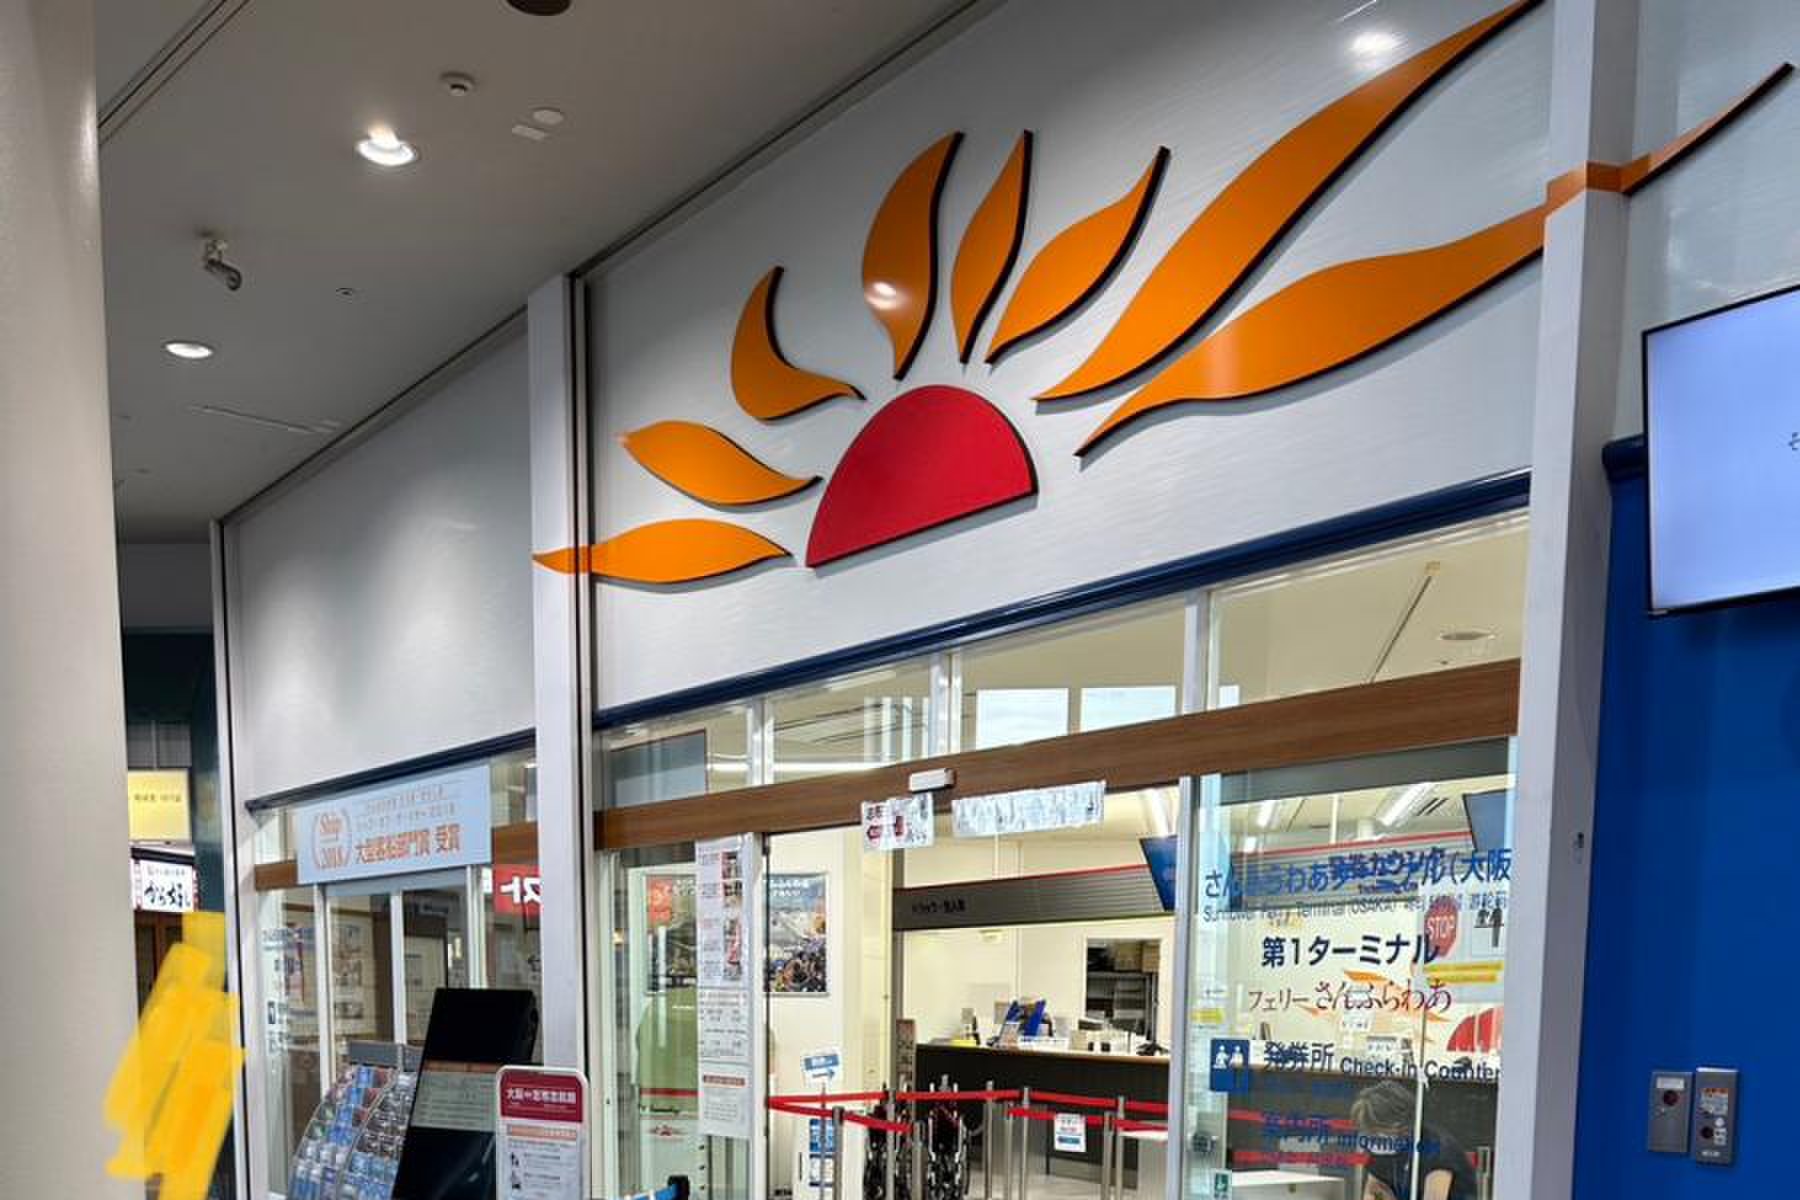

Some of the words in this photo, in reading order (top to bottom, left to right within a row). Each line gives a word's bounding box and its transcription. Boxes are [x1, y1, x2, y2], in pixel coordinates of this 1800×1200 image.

[1426, 912, 1457, 943] STOP
[1261, 934, 1440, 968] 第1ターミナル
